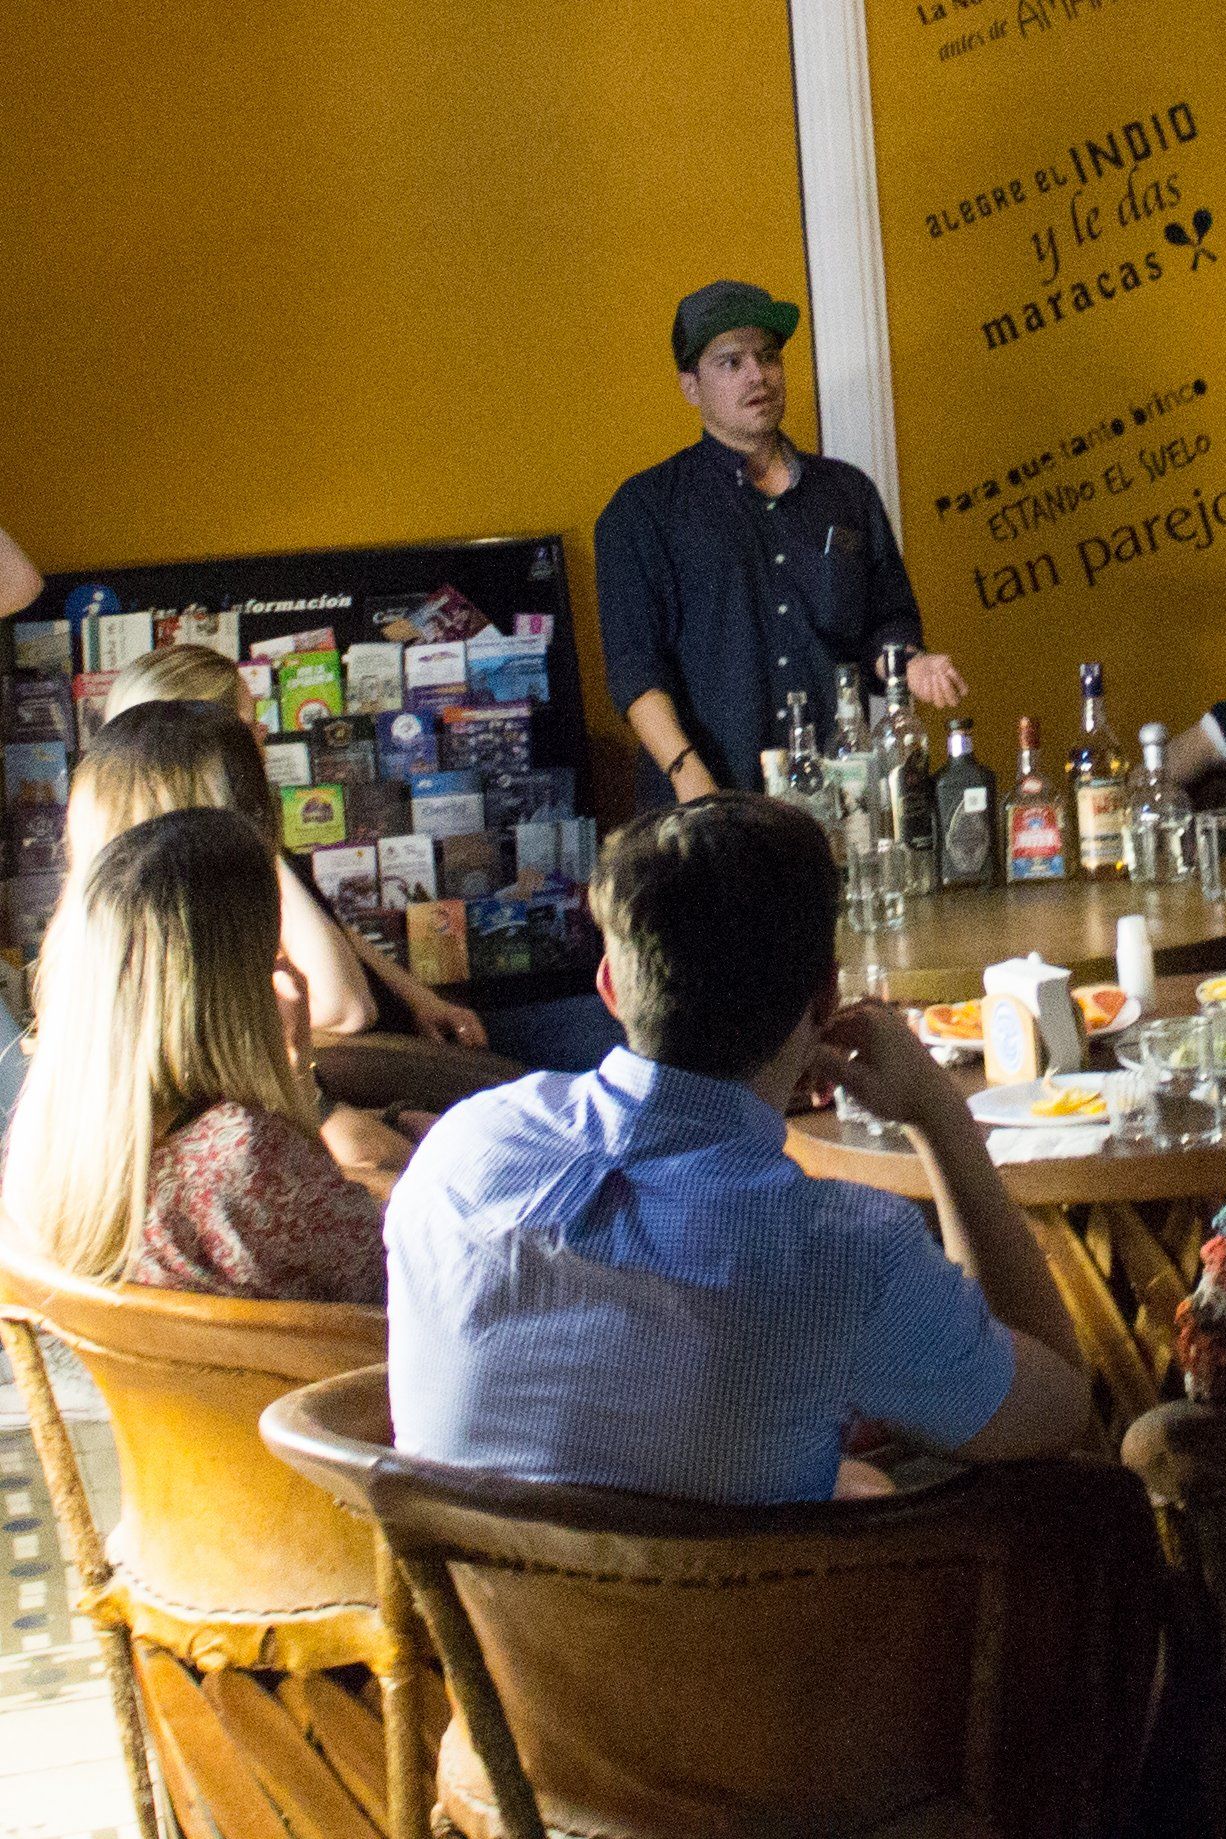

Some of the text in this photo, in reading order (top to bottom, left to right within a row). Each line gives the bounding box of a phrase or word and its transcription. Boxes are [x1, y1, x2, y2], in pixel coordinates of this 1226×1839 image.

[917, 4, 947, 27] La
[1068, 102, 1199, 184] INDIO
[1031, 165, 1183, 287] y le das
[982, 251, 1164, 350] maracas
[936, 378, 1207, 520] Para que tanto brinco
[987, 434, 1212, 543] ESTANDO EL SUELO
[974, 553, 1062, 610] tan
